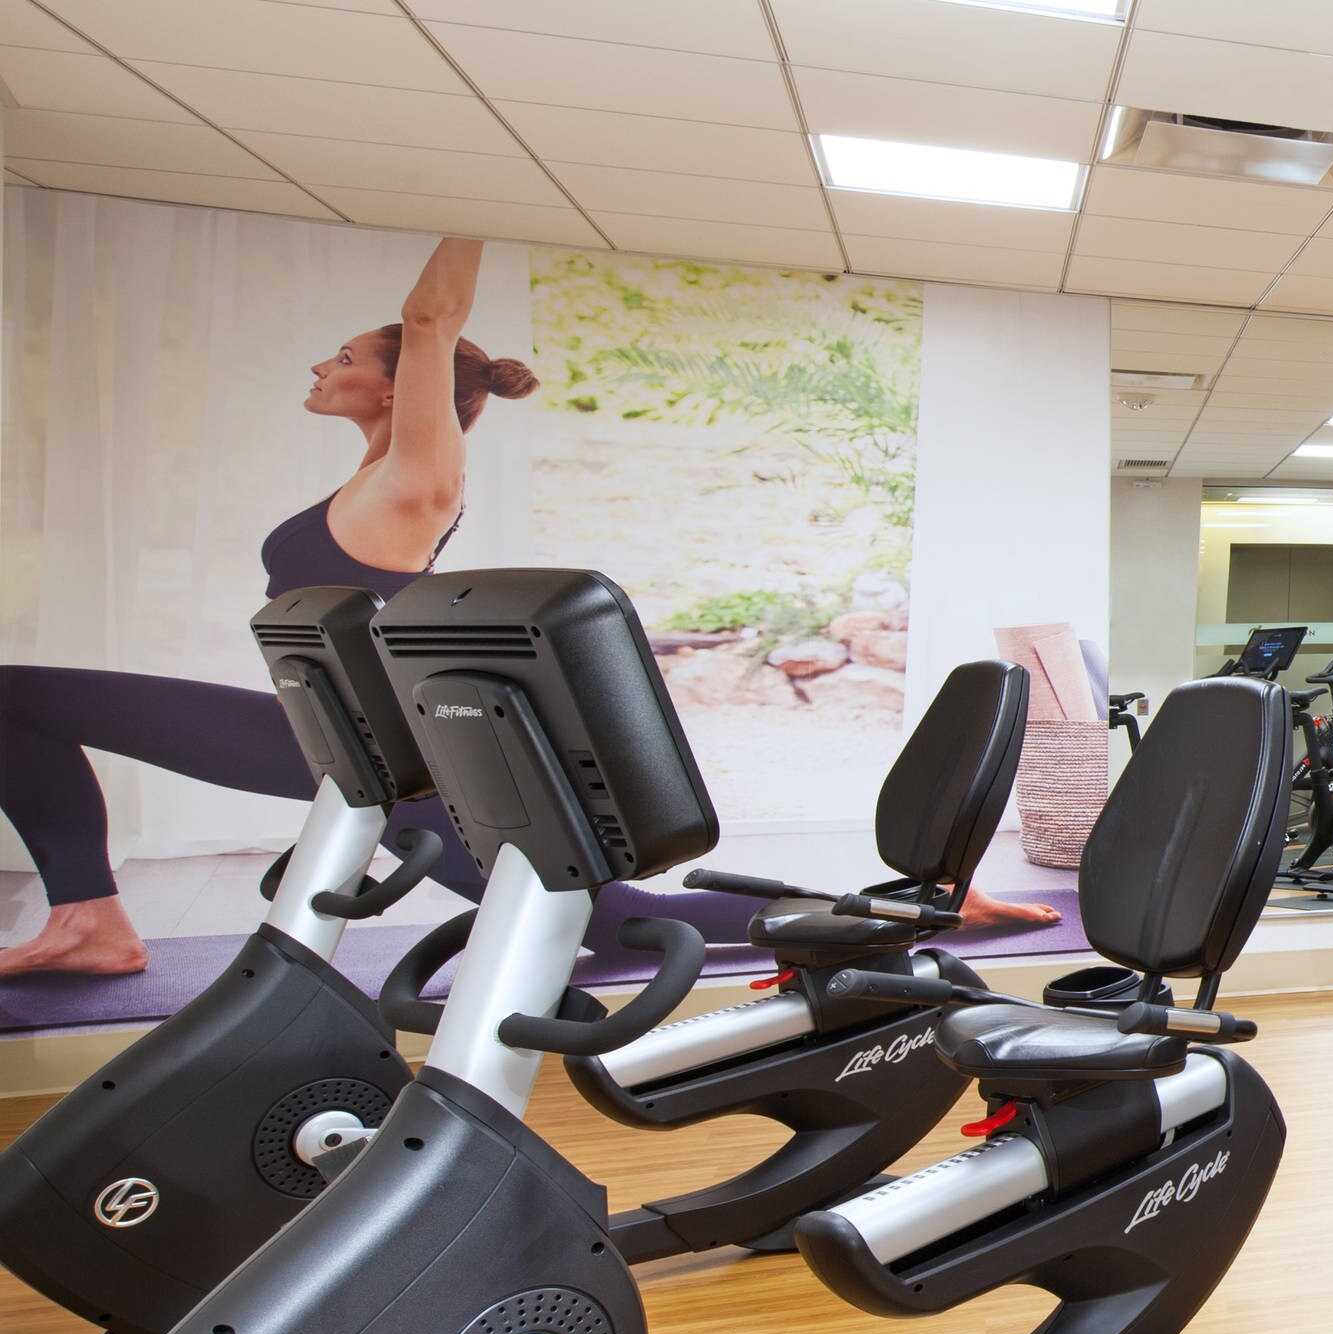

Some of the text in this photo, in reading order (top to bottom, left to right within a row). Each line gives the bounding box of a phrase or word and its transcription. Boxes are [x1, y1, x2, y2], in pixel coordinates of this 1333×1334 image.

[835, 1027, 936, 1082] Life Cycle
[1124, 1151, 1230, 1234] Life Cycle
